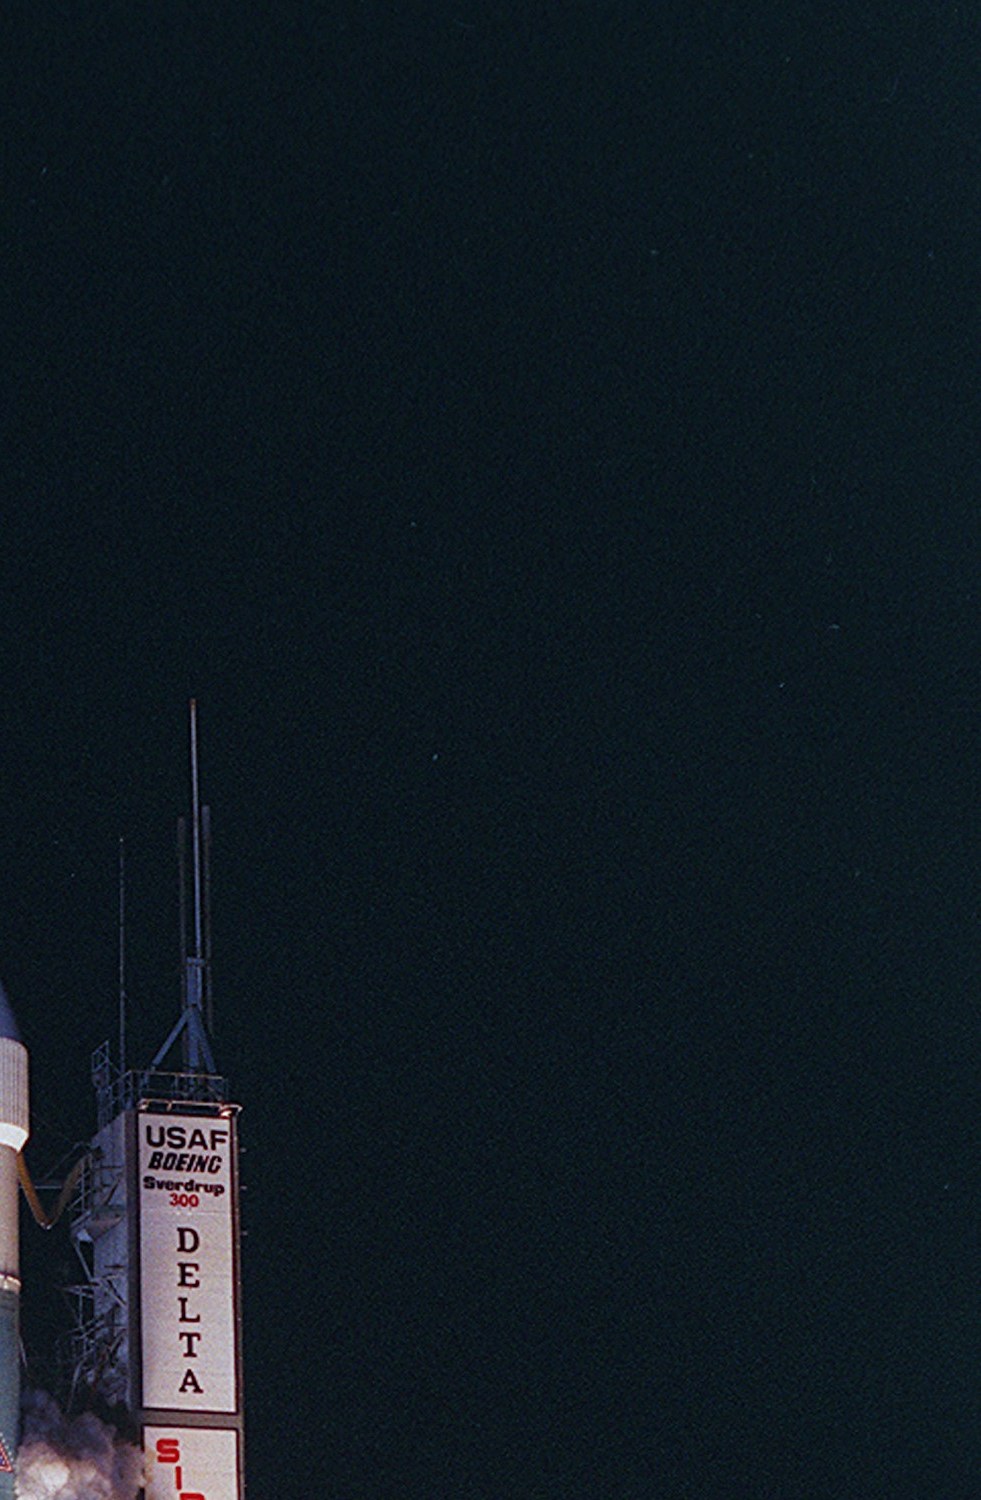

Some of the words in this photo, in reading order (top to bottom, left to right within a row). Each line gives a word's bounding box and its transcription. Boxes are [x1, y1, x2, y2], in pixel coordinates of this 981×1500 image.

[146, 1125, 228, 1150] USAF
[148, 1151, 222, 1174] BOEING
[143, 1176, 225, 1197] Sverdrup
[169, 1193, 199, 1208] 300
[176, 1227, 203, 1393] DELTA
